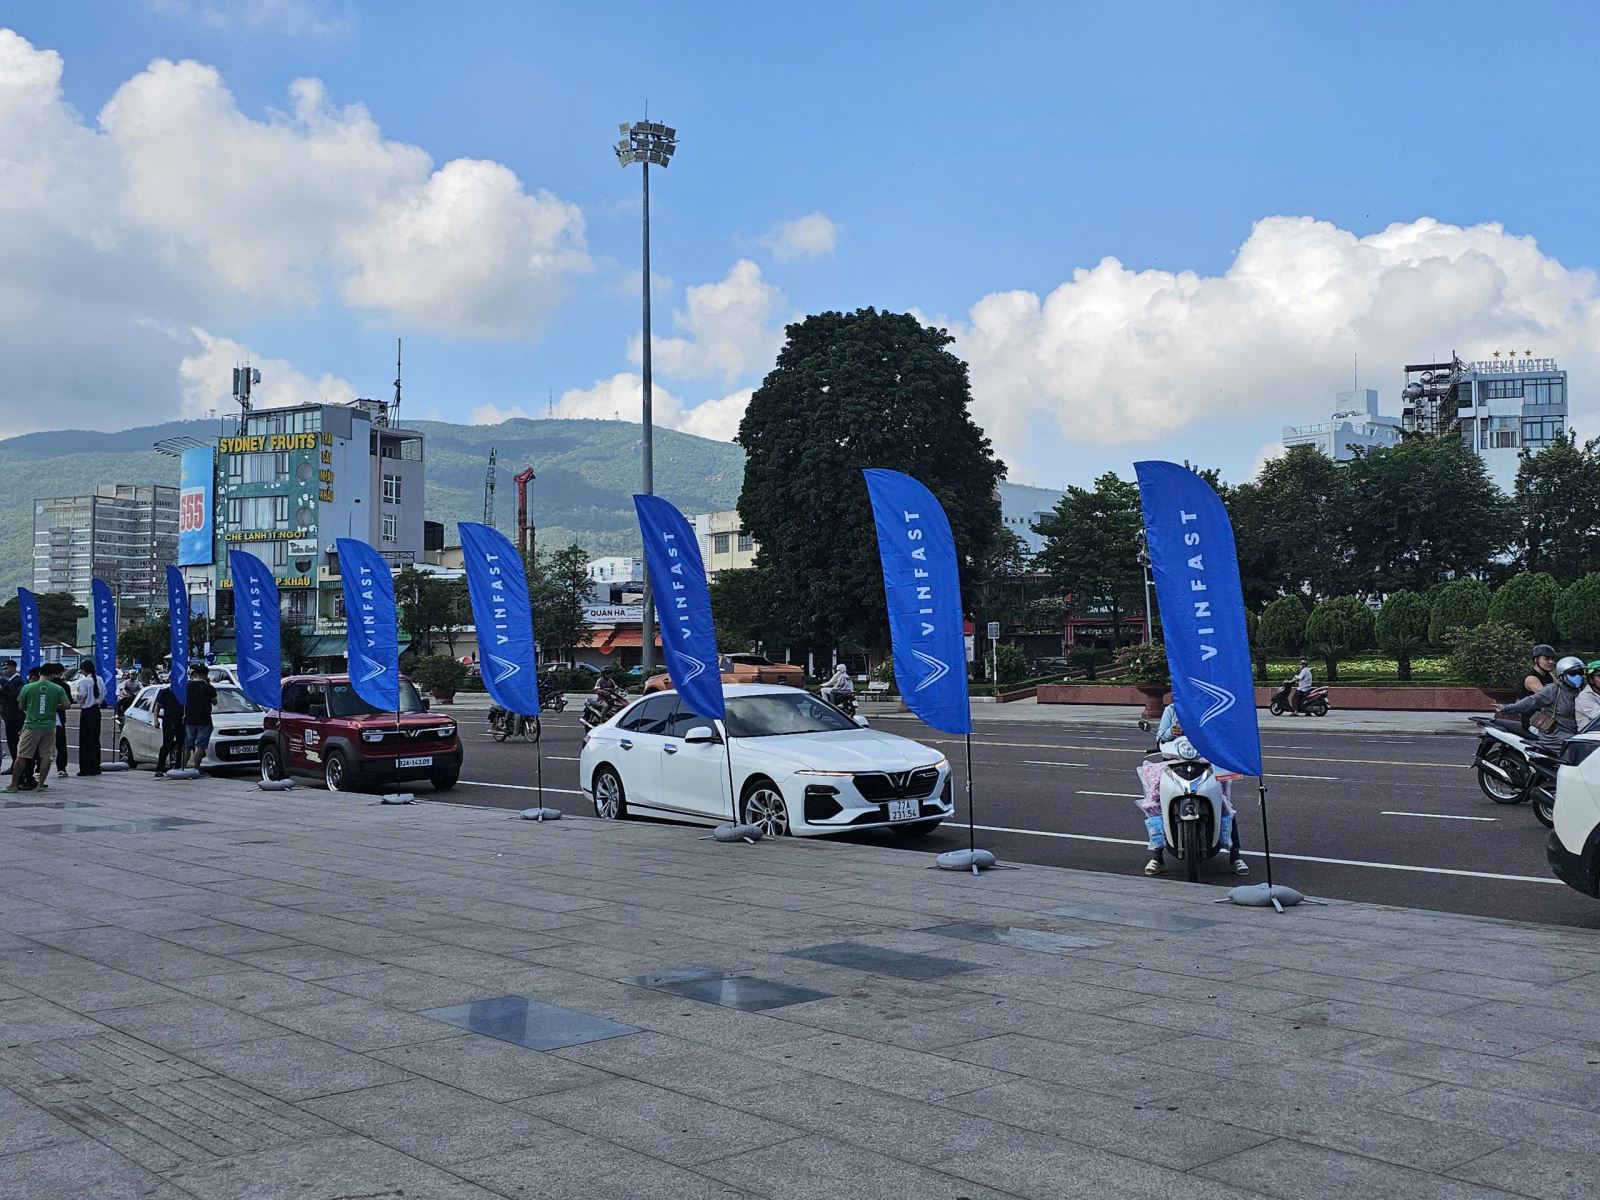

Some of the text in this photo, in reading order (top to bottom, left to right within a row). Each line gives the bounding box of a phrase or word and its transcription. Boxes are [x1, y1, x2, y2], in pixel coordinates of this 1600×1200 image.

[1468, 358, 1557, 373] ATHENA HOTEL
[220, 433, 316, 453] SYDNEY FRUITS
[180, 493, 204, 531] 555
[486, 553, 509, 645] VINFAST
[663, 532, 692, 639] VINFAST
[904, 511, 935, 636] VINFAST
[1179, 510, 1218, 661] VINFAST
[101, 599, 109, 660] VINFAST
[250, 577, 263, 650] VINFAST
[360, 567, 376, 648] VINFAST
[892, 809, 917, 820] 231.54
[897, 801, 911, 809] 77A
